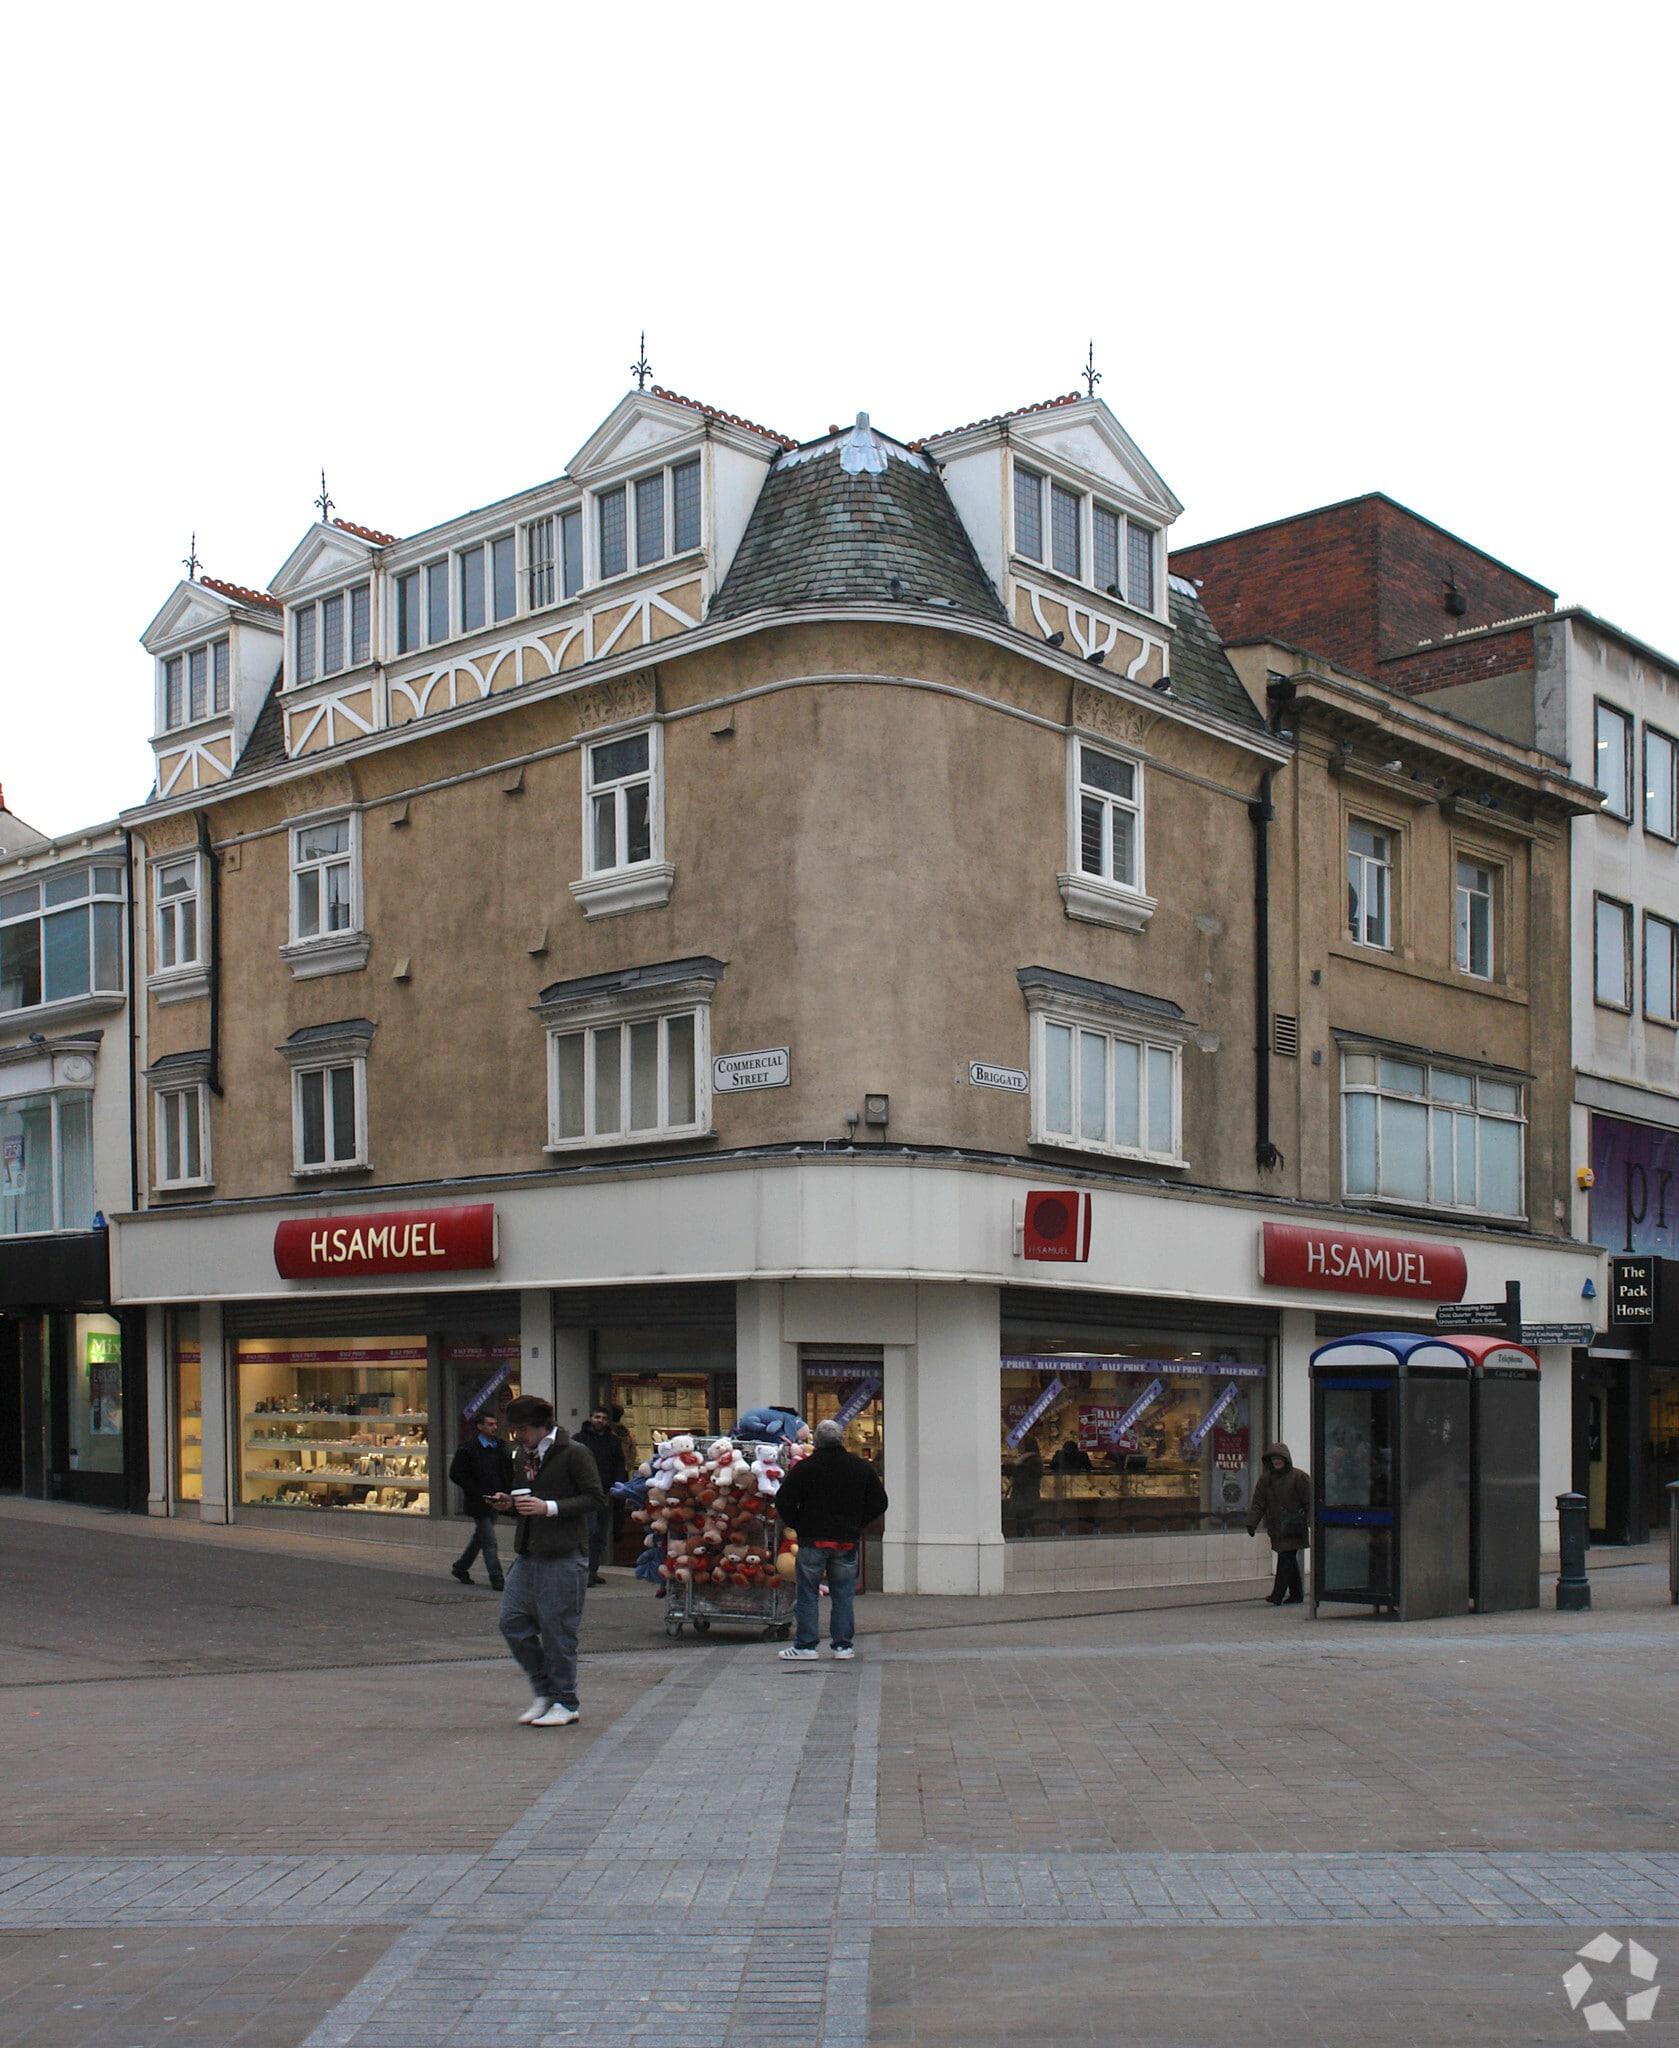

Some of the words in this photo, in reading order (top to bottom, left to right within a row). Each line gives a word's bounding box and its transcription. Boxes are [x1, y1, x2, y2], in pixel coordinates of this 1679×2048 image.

[718, 1056, 783, 1073] COMMERCIAL
[732, 1072, 769, 1086] STREET
[976, 1066, 1023, 1088] BRIGGATE
[310, 1222, 446, 1263] H.SAMUEL
[1307, 1241, 1432, 1285] H.SAMUEL
[1621, 1266, 1646, 1278] The
[1619, 1285, 1648, 1297] Pack
[1616, 1304, 1651, 1317] Horse
[1006, 1361, 1031, 1369] PRICE
[1037, 1362, 1059, 1370] HALF
[1060, 1362, 1085, 1371] PRICE
[1102, 1363, 1121, 1372] HALF
[1123, 1364, 1146, 1372] PRICE
[1163, 1365, 1181, 1373] HALF
[1183, 1365, 1204, 1374] PRICE
[1220, 1367, 1239, 1375] HALF
[1240, 1368, 1260, 1376] PRICE
[1016, 1416, 1036, 1440] HALF
[1033, 1392, 1055, 1418] PRICE
[1120, 1414, 1136, 1434] HALF
[1136, 1394, 1154, 1416] PRICE
[1200, 1416, 1215, 1438] HALF
[1214, 1396, 1231, 1419] PRICE
[1218, 1453, 1243, 1461] HALF
[1216, 1461, 1247, 1469] PRICE
